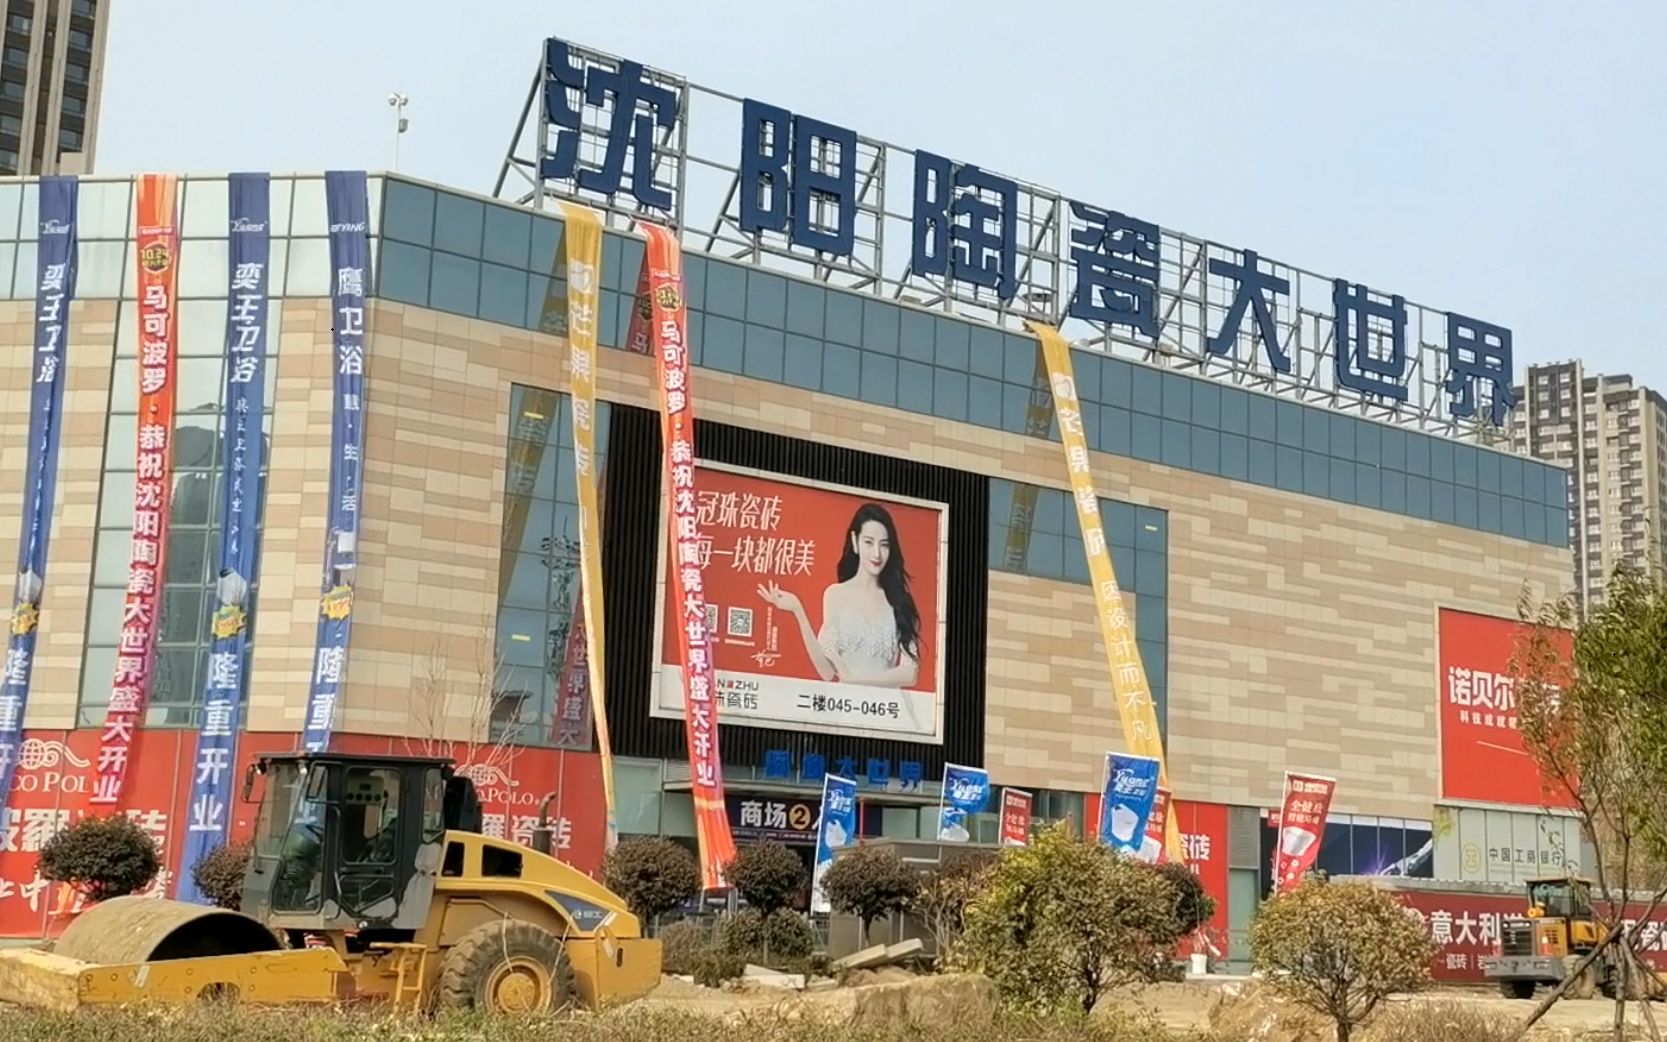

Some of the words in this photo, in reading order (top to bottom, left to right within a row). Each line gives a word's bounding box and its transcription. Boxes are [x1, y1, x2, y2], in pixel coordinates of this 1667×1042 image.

[540, 38, 1517, 427] 沈阳陶瓷大世界
[337, 266, 365, 375] 鹰卫浴
[696, 490, 783, 532] 冠珠瓷砖
[797, 694, 900, 719] 二楼045-046号
[1100, 579, 1154, 742] 因设计而不凡
[189, 652, 240, 833] 隆重开业
